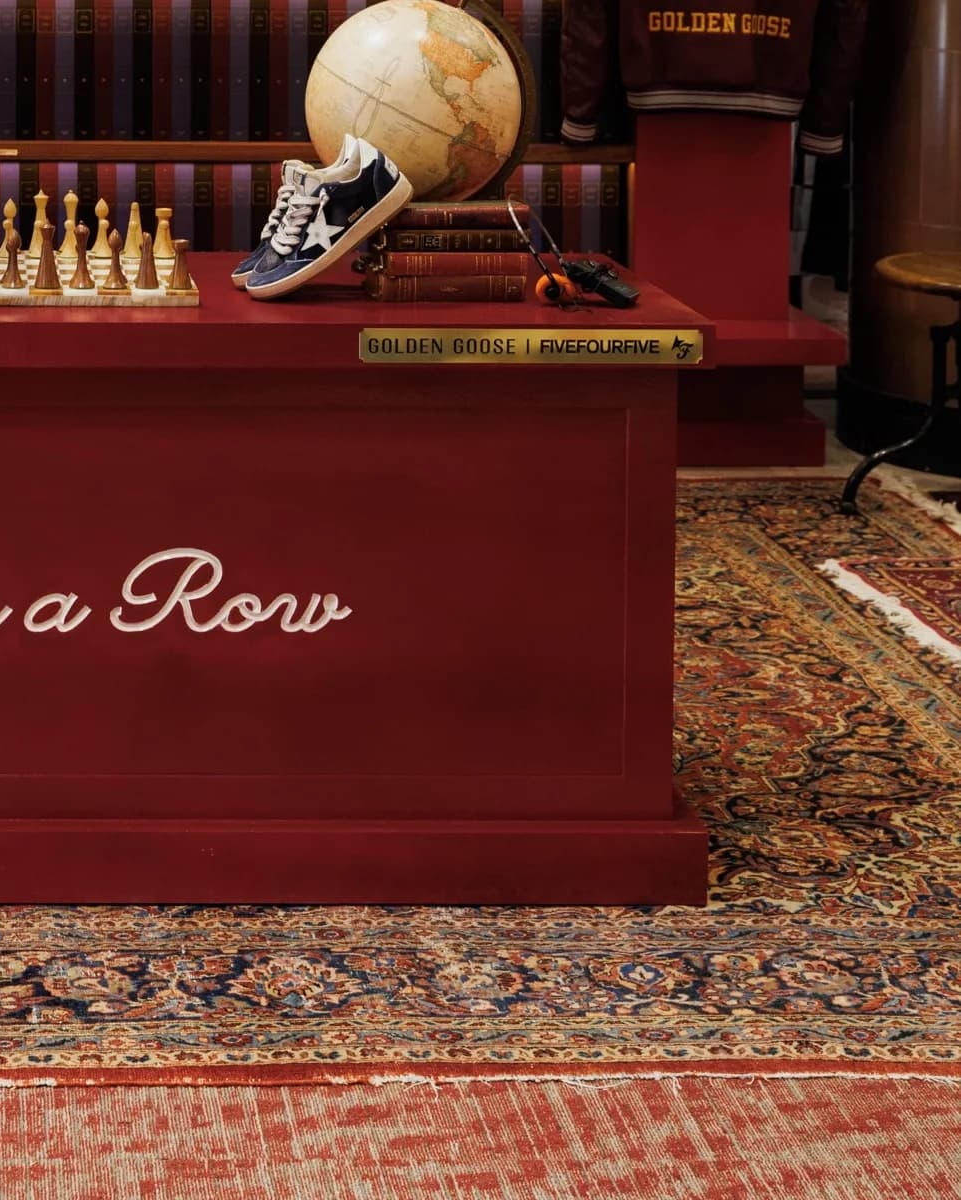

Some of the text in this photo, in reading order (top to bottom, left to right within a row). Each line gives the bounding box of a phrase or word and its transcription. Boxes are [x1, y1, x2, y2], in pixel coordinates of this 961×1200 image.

[648, 11, 792, 39] GOLDEN GOOSE
[367, 338, 443, 355] GOLDEN
[453, 338, 516, 355] GOOSE
[539, 338, 660, 354] FIVEFOURFIVE
[23, 591, 92, 633] a
[109, 547, 352, 633] Row
